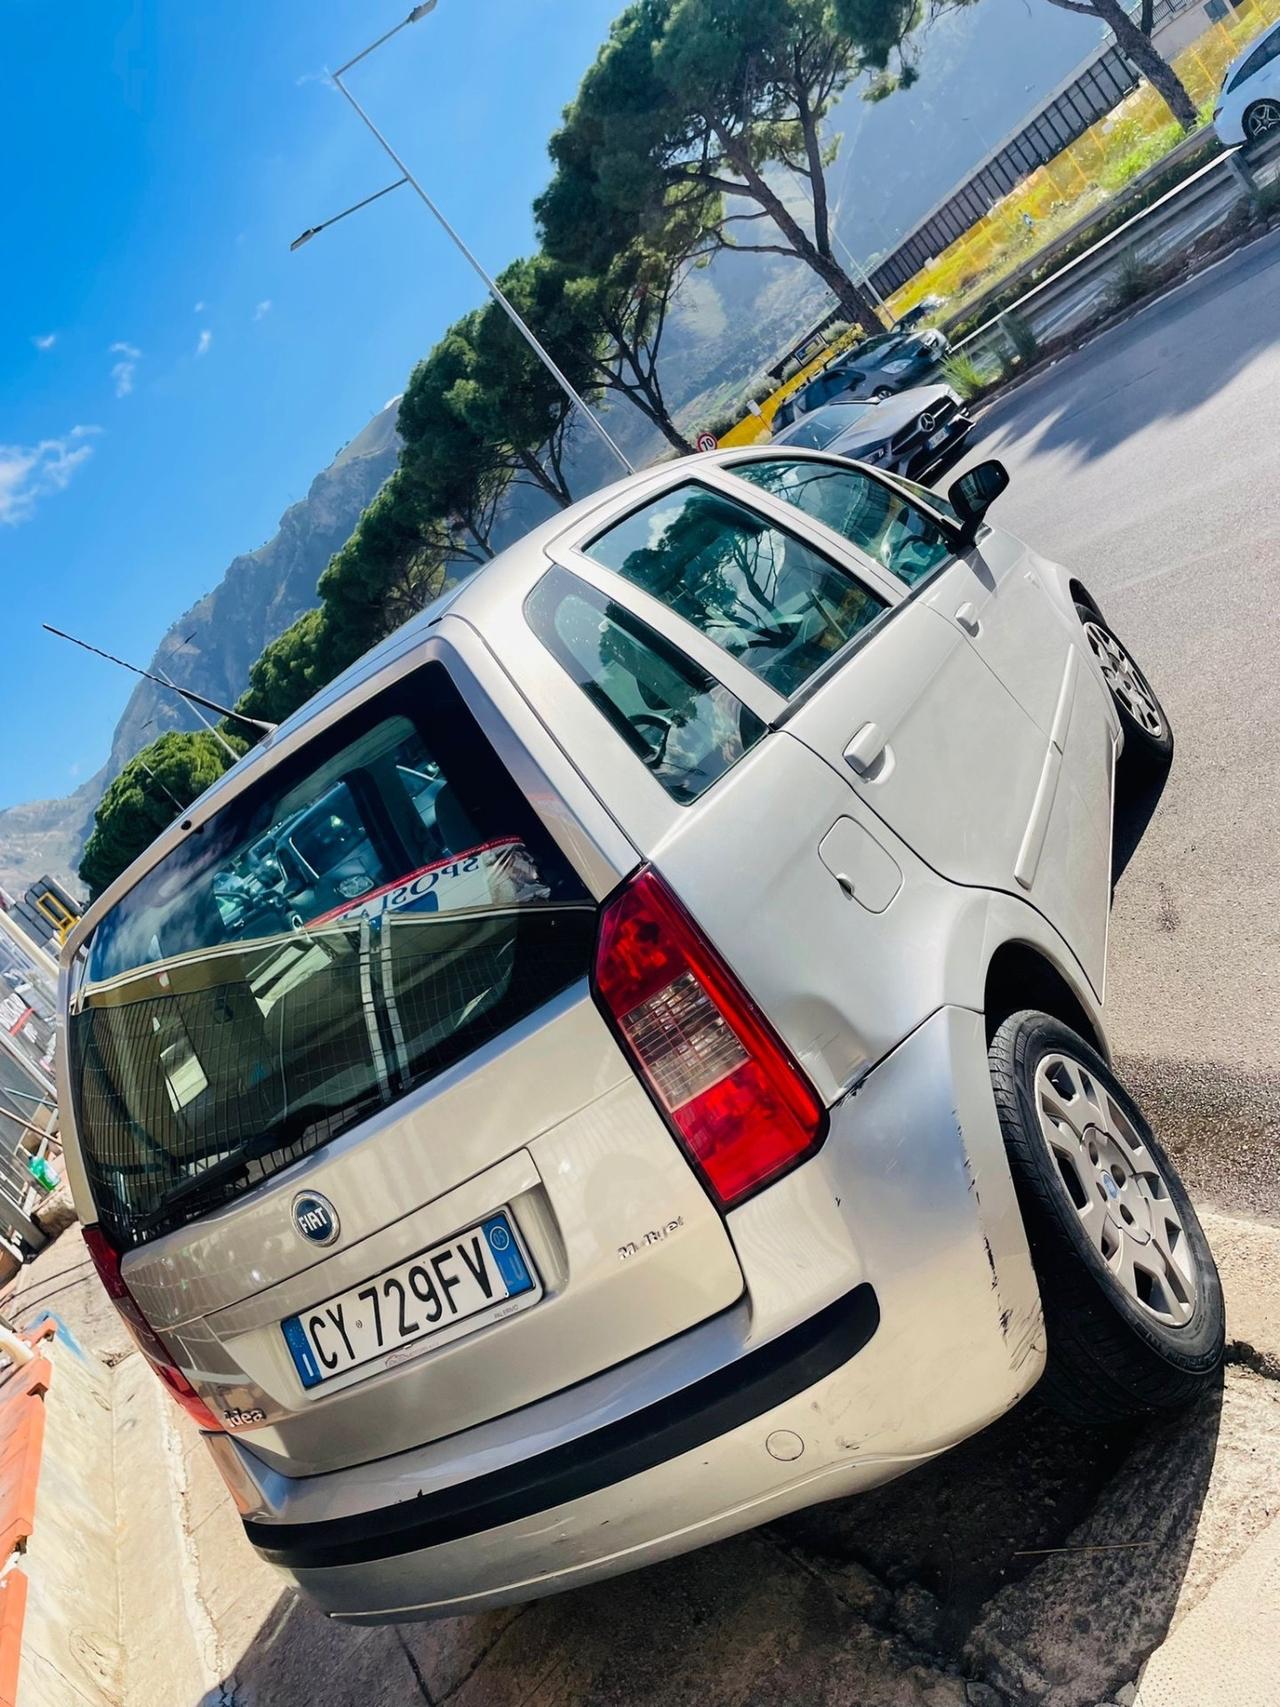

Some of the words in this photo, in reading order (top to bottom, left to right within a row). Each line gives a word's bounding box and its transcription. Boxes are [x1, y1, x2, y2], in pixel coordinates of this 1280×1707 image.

[299, 1206, 327, 1233] FIAT
[308, 1304, 355, 1369] CY
[358, 1236, 493, 1347] 729FV
